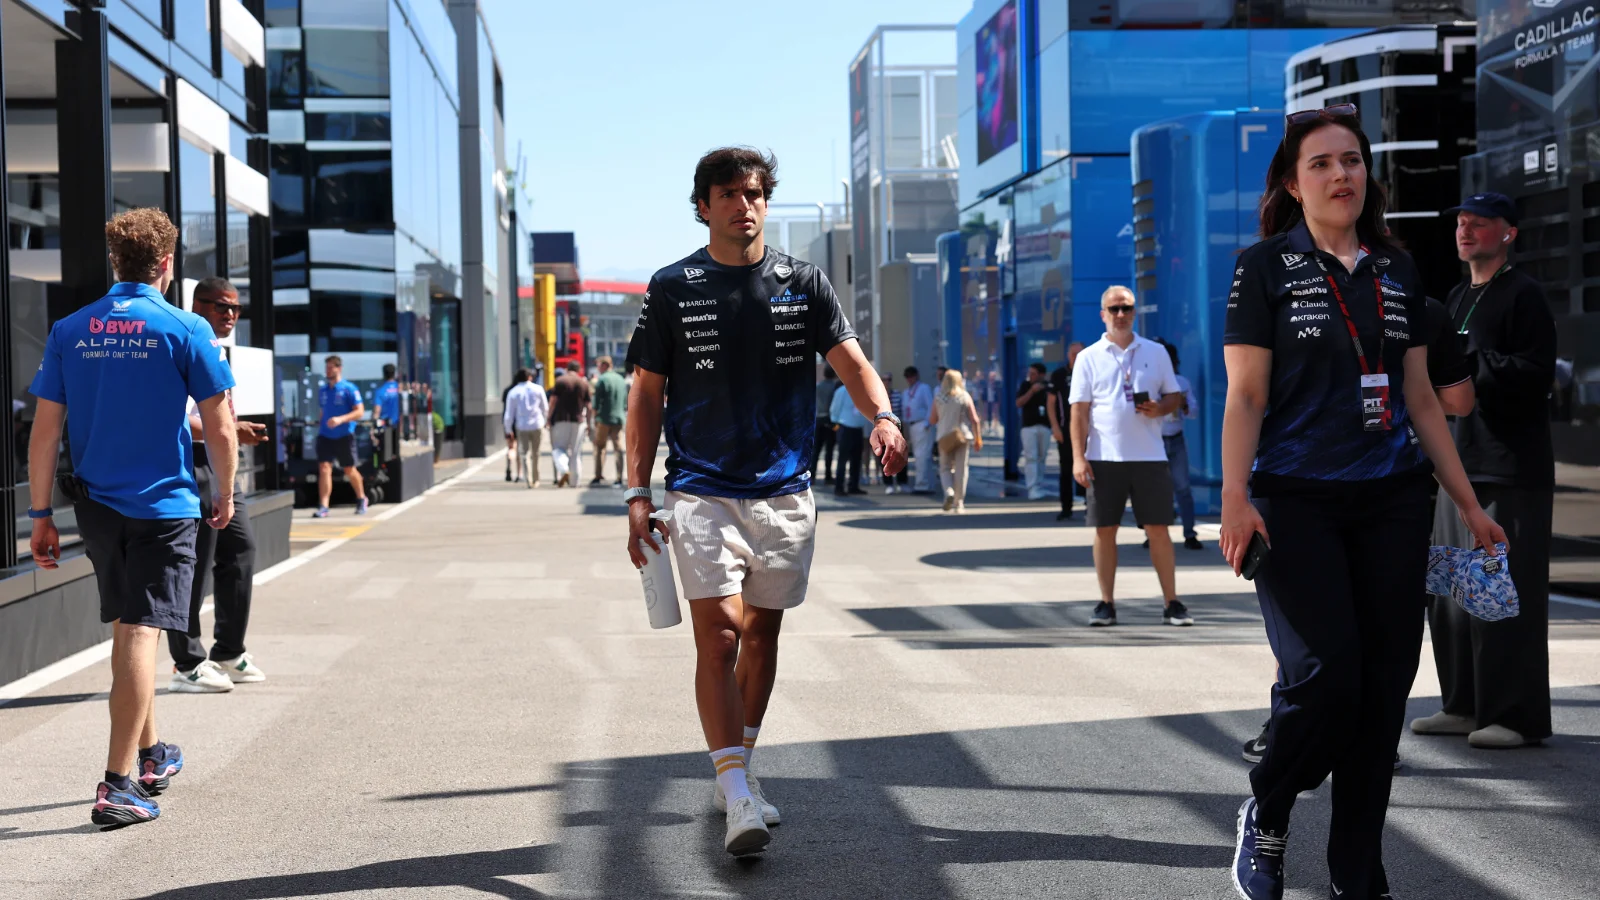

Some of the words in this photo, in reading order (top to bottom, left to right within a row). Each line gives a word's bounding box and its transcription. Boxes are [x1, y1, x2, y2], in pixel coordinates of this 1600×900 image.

[1514, 6, 1595, 51] CADILLAC
[1515, 45, 1559, 70] FORMULA
[1567, 32, 1595, 51] TEAM
[1291, 286, 1328, 296] KOMATSU
[686, 299, 717, 307] BARCLAYS
[770, 294, 808, 303] ATLASSIAN
[770, 304, 809, 313] Williams
[682, 313, 717, 323] KOMATSU
[1298, 313, 1330, 321] kraken
[105, 320, 146, 334] BWT
[774, 323, 806, 331] DURACELL
[691, 329, 719, 338] Claude
[1384, 328, 1410, 341] Stephen
[74, 338, 158, 349] ALPINE
[692, 343, 721, 352] kraken
[82, 350, 110, 359] FORMULA
[131, 351, 148, 359] TEAM
[775, 355, 804, 365] Stephens
[1363, 397, 1383, 408] PIT
